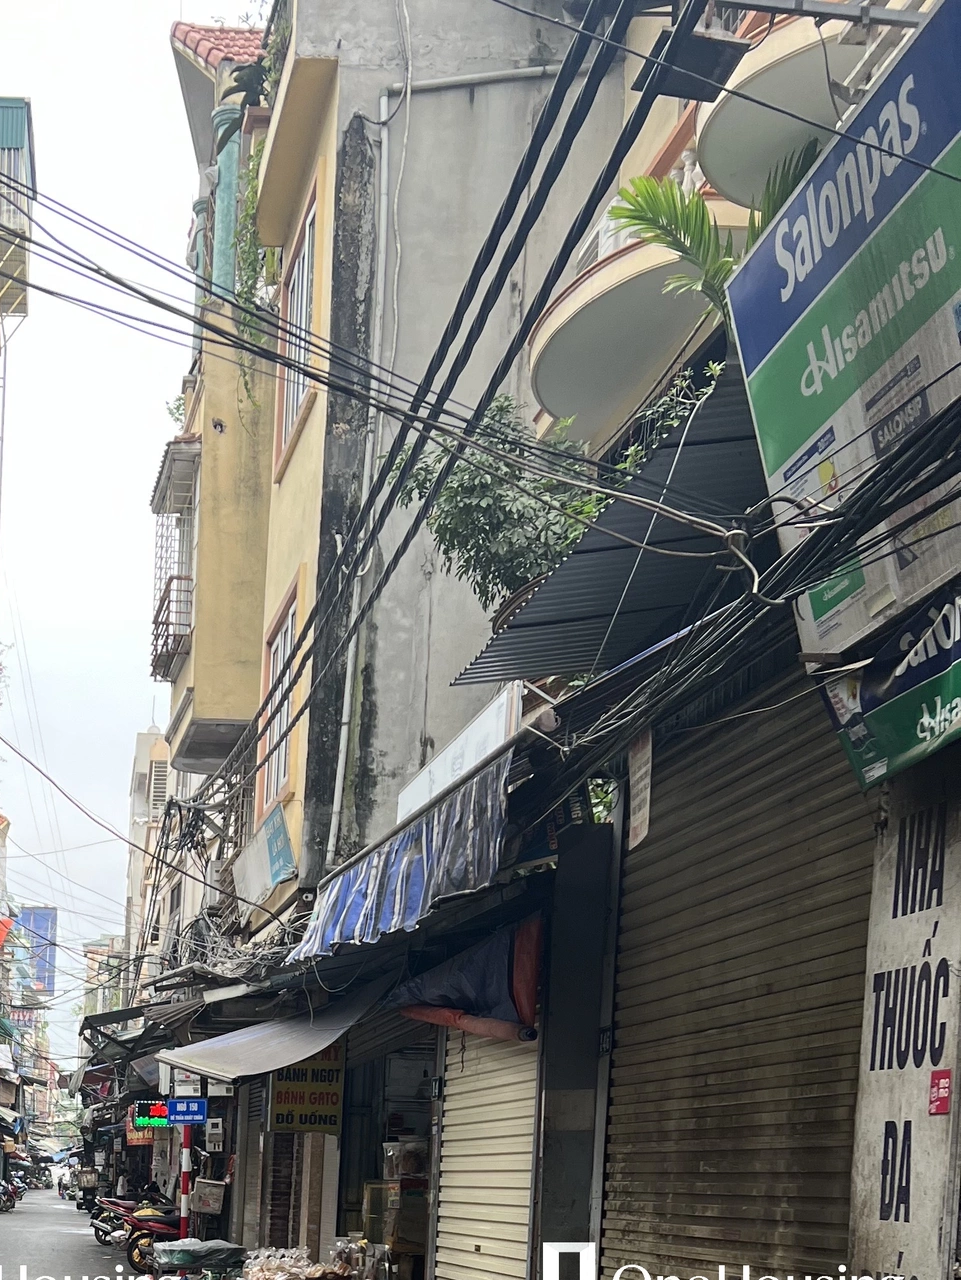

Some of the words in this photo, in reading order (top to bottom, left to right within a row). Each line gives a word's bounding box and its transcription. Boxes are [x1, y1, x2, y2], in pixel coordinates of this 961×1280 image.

[774, 73, 920, 302] Salonpas
[801, 226, 948, 397] Hisamitsu
[869, 919, 950, 1072] THUỐC
[276, 1087, 305, 1105] BÁNH
[309, 1092, 339, 1106] GATO
[299, 1110, 337, 1125] UỐNG
[311, 1068, 340, 1086] NGỌT
[879, 1120, 912, 1223] ĐA
